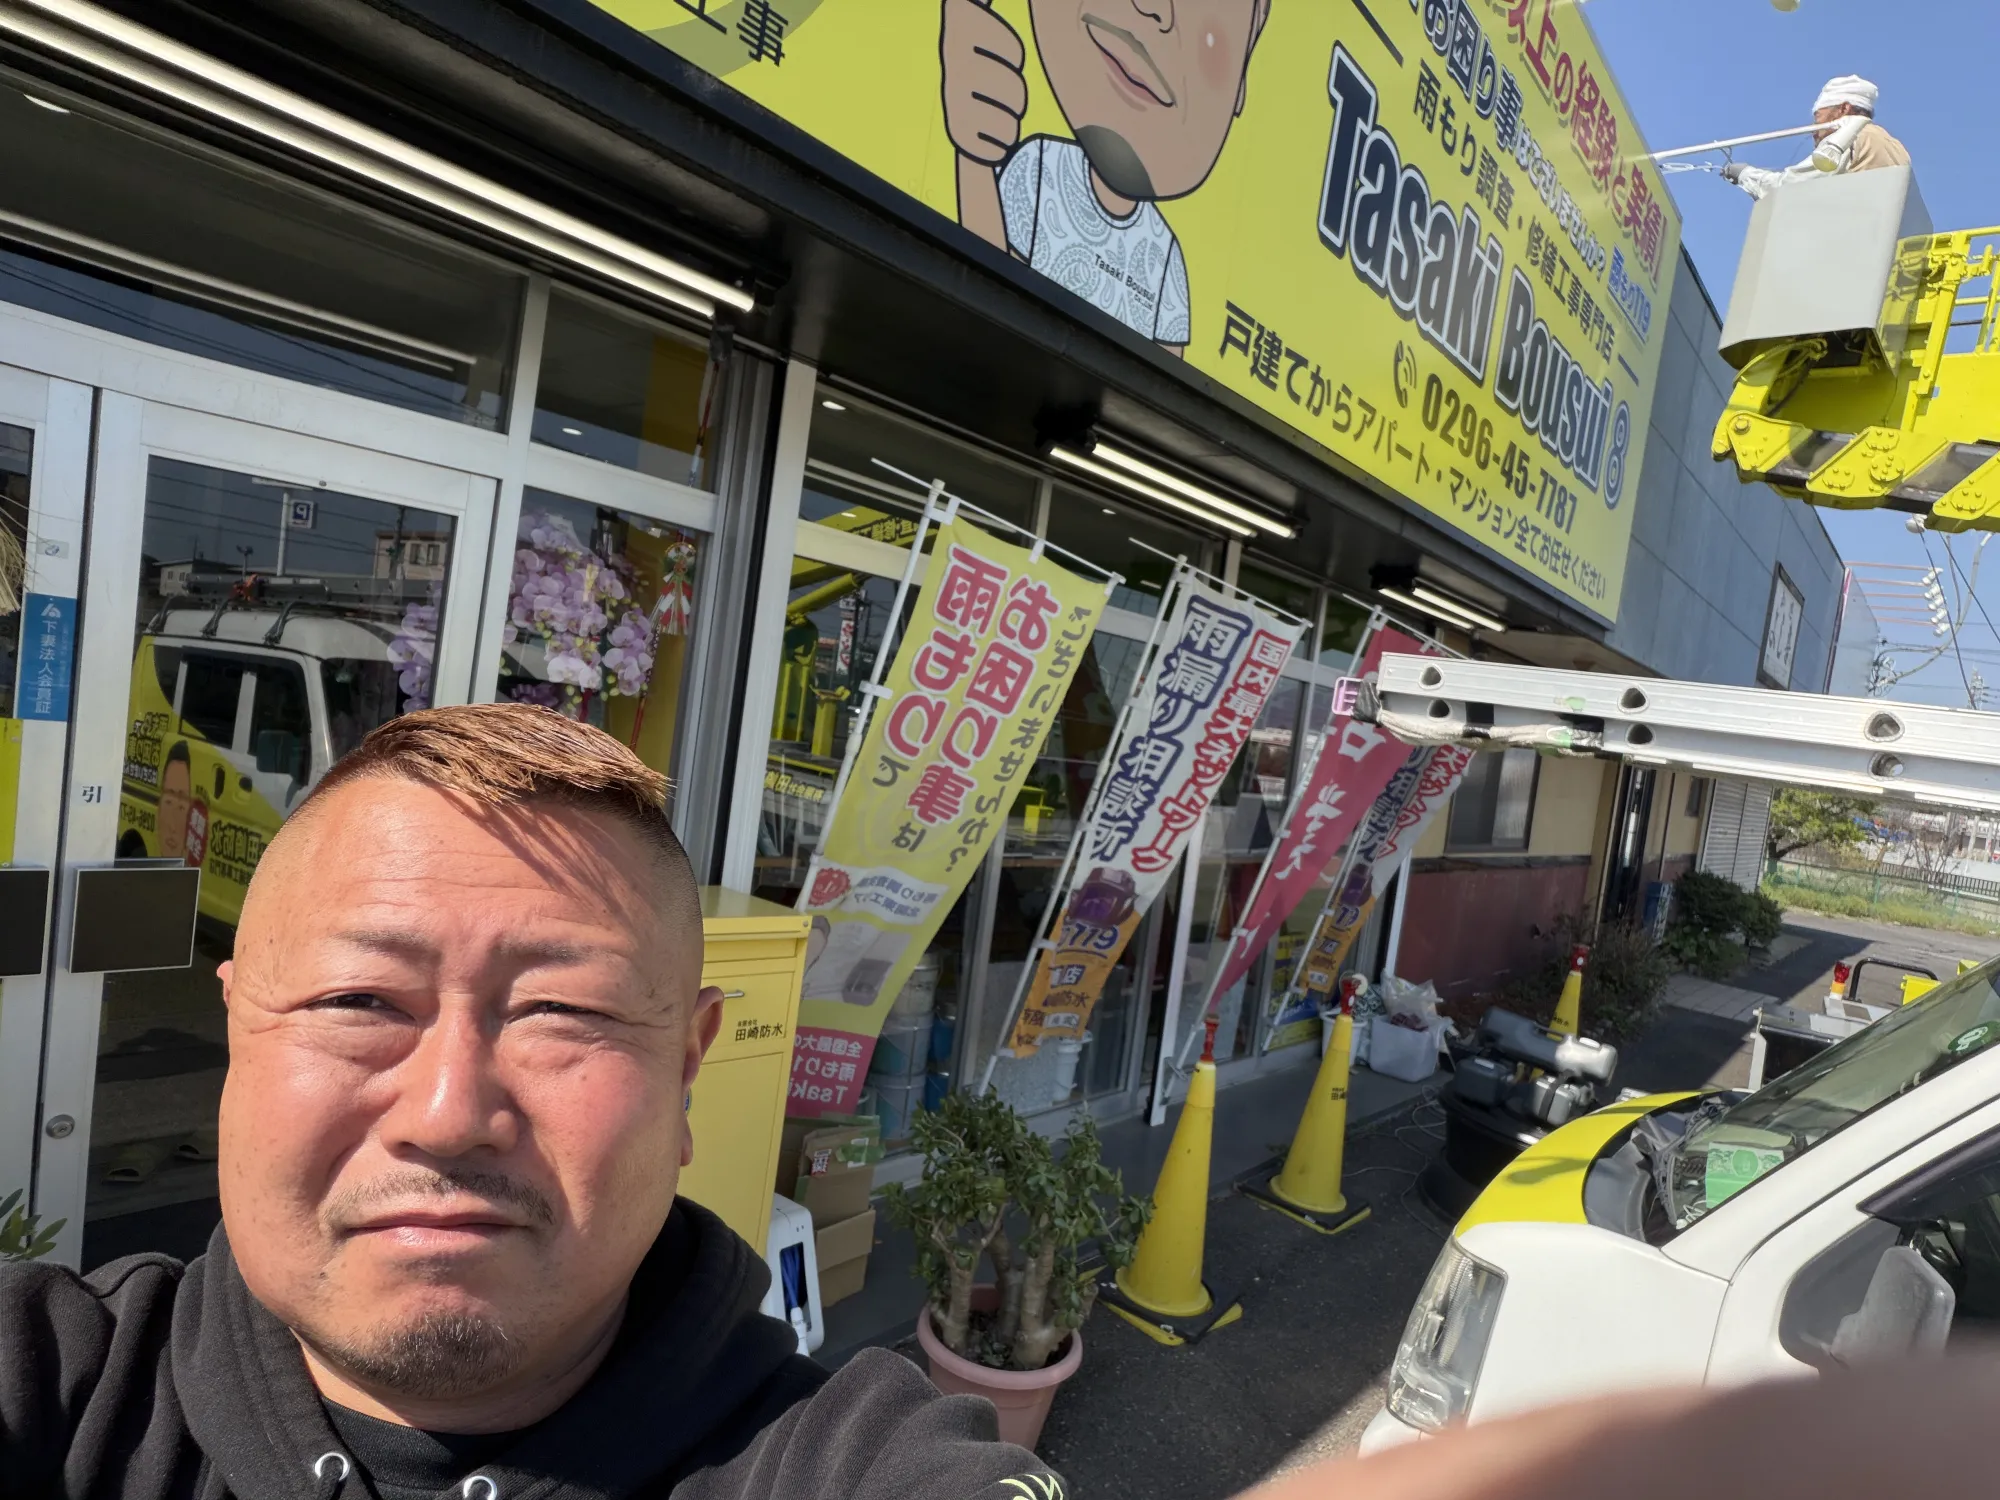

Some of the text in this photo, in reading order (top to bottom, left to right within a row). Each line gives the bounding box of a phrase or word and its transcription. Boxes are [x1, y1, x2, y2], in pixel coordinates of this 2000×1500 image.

[1094, 253, 1125, 284] Tasaki
[1318, 40, 1503, 387] Tasaki
[1495, 265, 1613, 493] Bousui
[1220, 300, 1607, 601] 戸建てからアパート・マンション全てお任せください
[1422, 373, 1578, 536] 0296-45-7787
[81, 785, 103, 804] 引
[1089, 594, 1253, 862] 雨漏り相談所
[1131, 629, 1291, 873] 国内最大ネットワーク
[735, 1022, 783, 1042] 田崎防水
